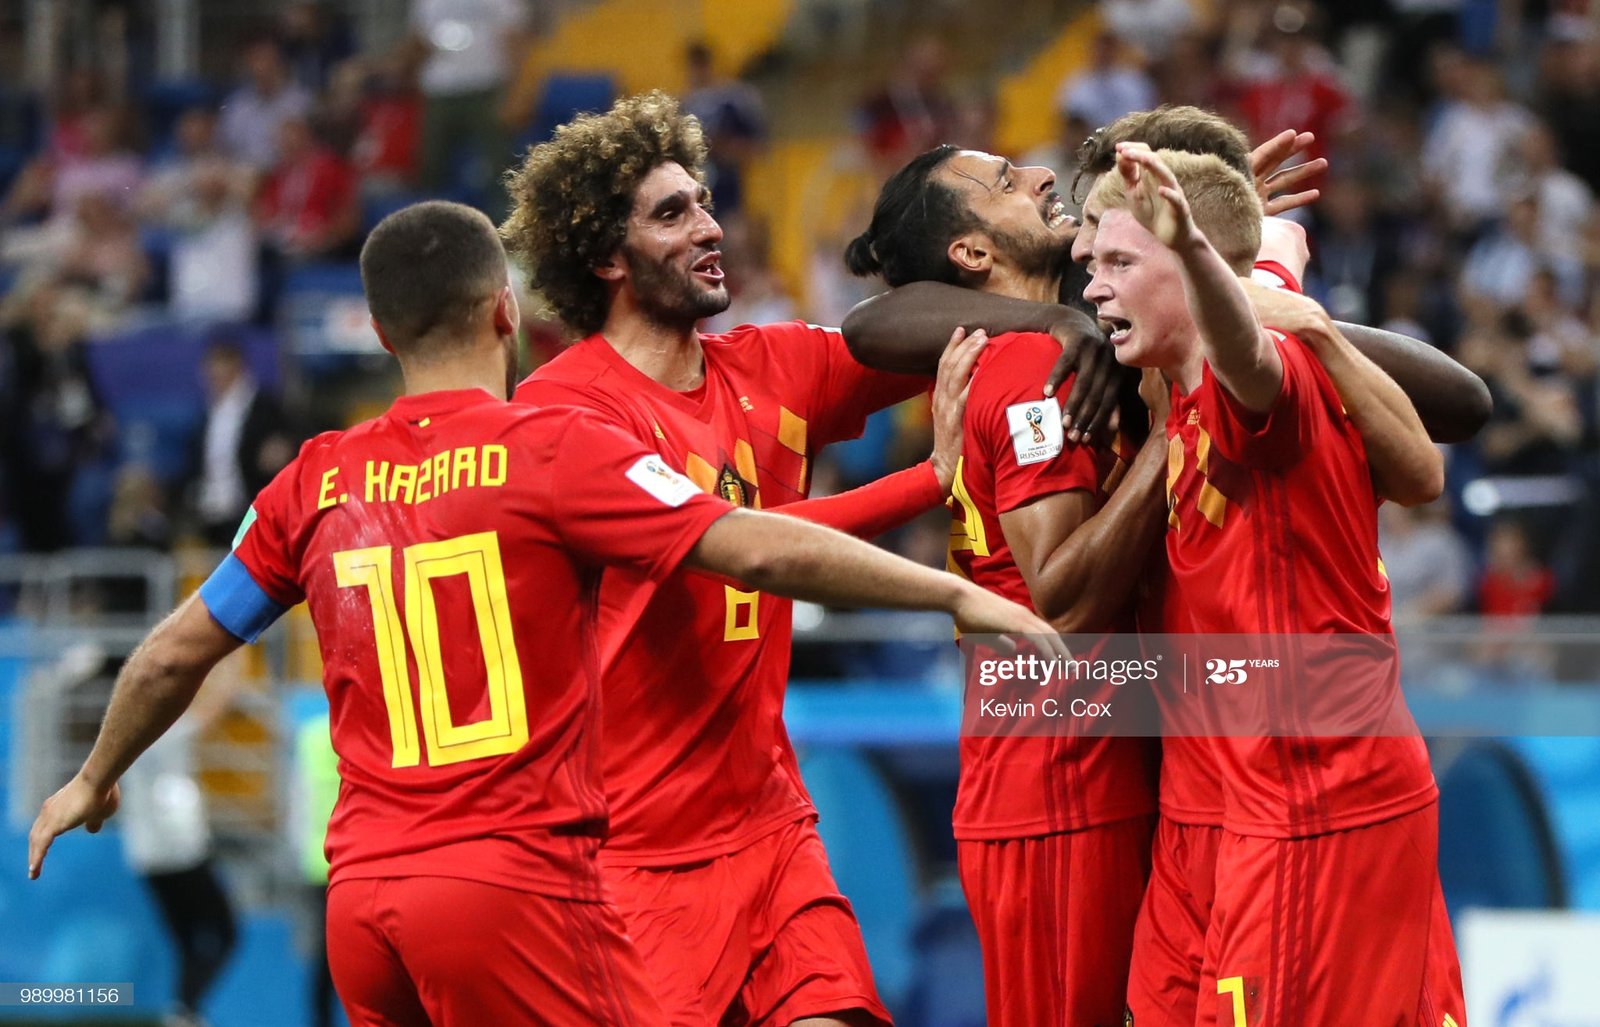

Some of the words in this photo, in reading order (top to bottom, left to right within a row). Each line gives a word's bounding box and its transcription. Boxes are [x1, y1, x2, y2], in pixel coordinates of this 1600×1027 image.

[317, 466, 348, 510] E.
[365, 444, 508, 505] HAZARD
[1019, 449, 1047, 460] RUSSIA
[332, 530, 530, 769] 10
